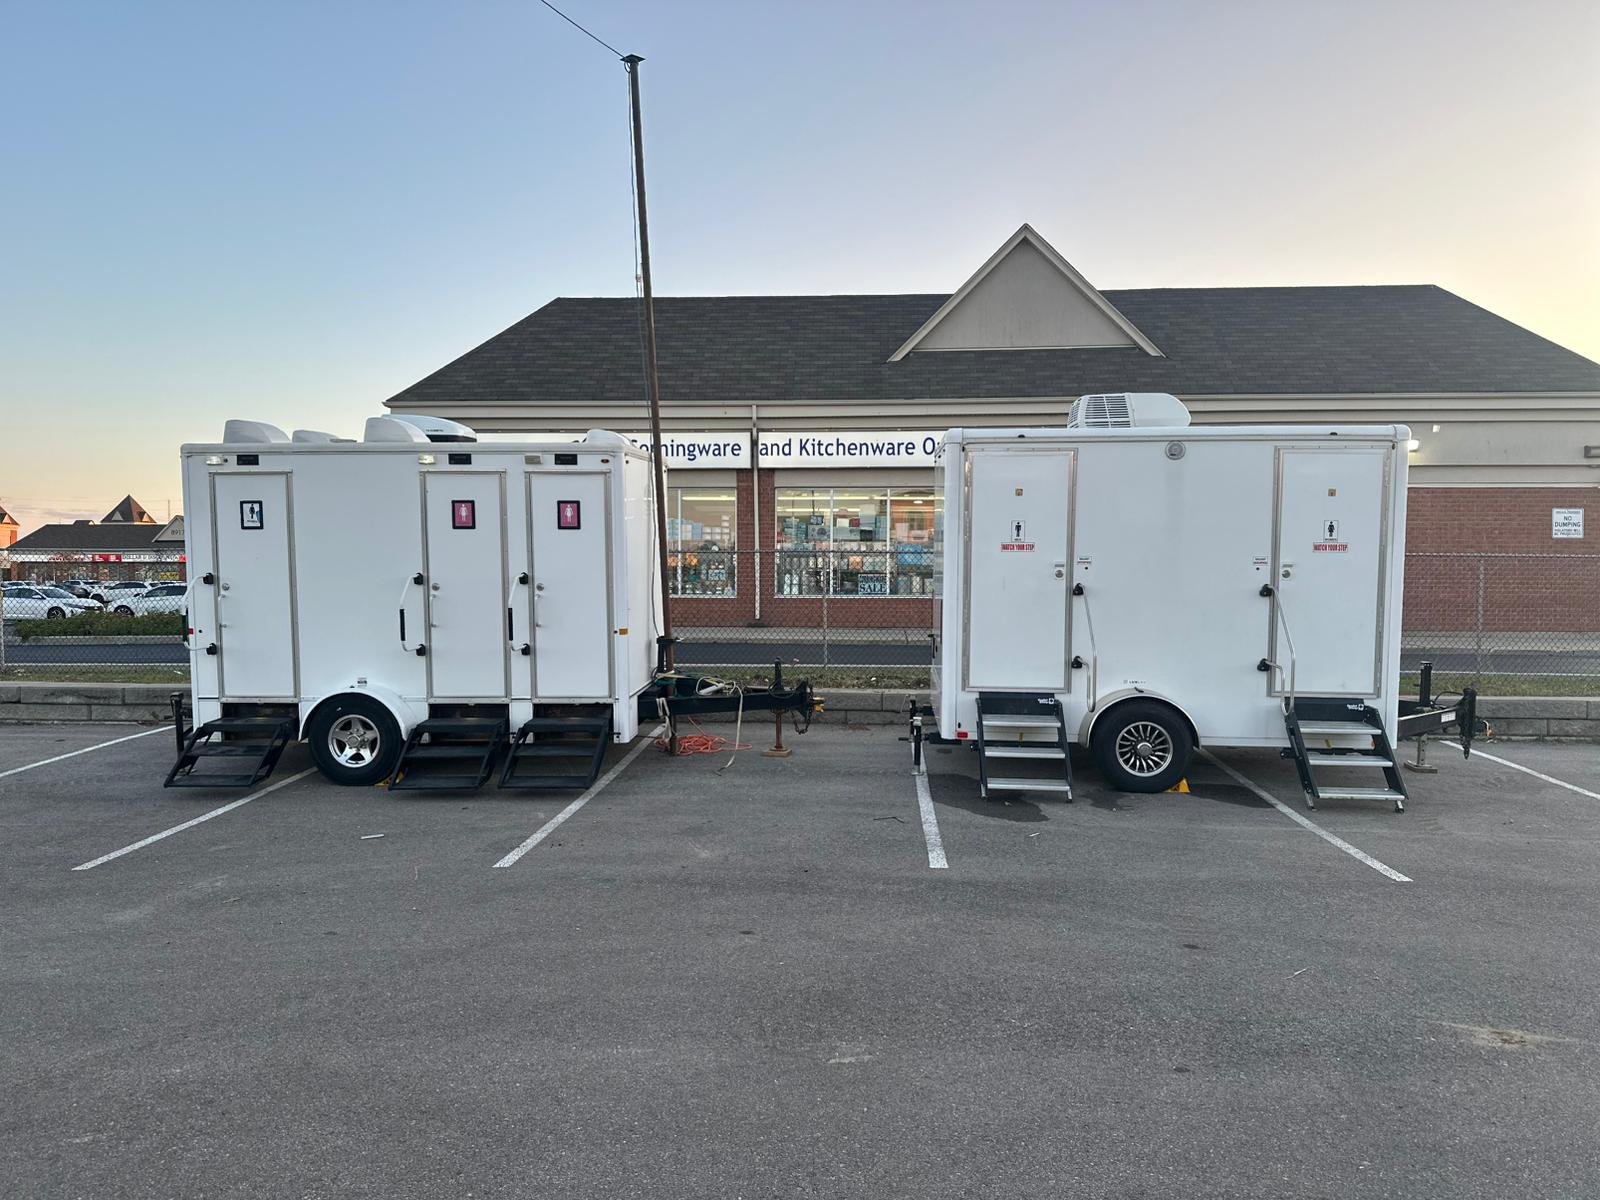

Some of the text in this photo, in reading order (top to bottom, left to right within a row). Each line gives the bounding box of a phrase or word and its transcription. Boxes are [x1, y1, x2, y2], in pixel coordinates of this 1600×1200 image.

[759, 438, 792, 456] and
[800, 437, 916, 456] Kitchenware
[923, 437, 940, 455] O
[1015, 543, 1025, 551] YOUR
[1025, 543, 1035, 551] STEP
[859, 583, 887, 593] SALE
